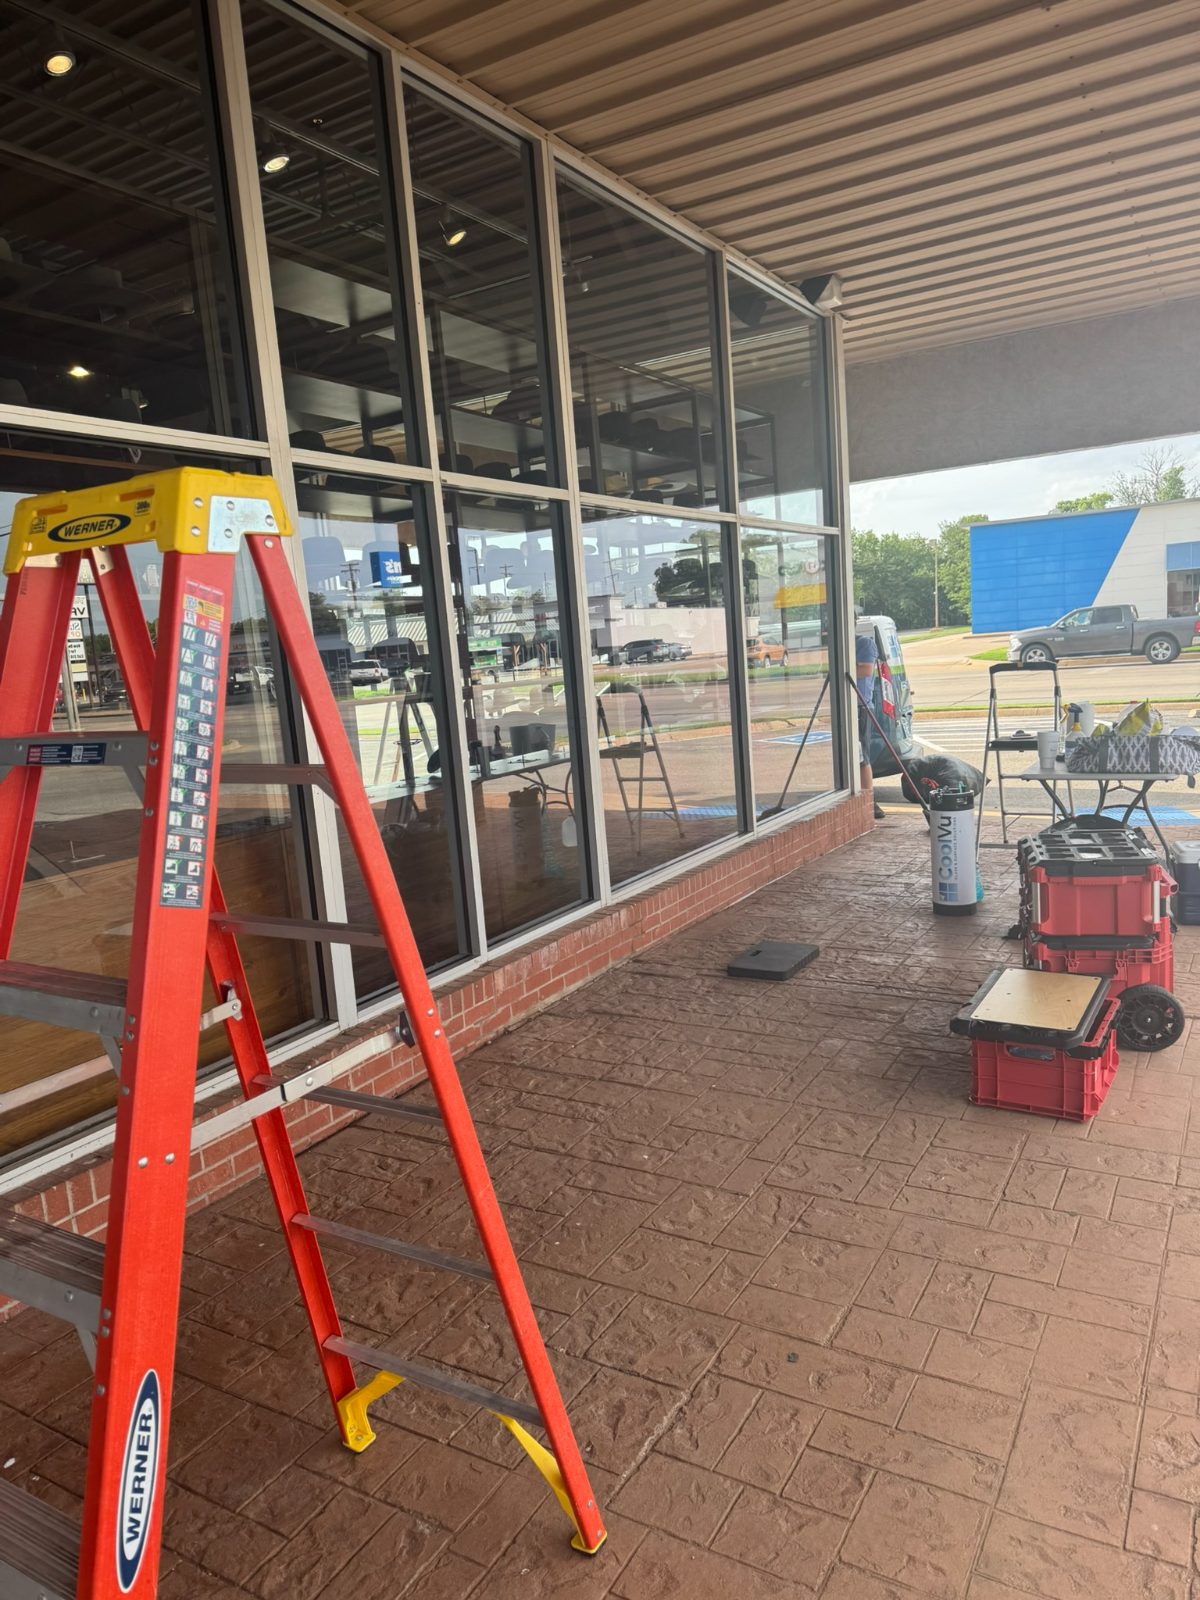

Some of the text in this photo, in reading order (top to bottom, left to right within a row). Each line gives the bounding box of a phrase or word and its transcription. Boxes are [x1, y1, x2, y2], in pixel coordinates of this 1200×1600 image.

[63, 519, 115, 537] WERNER
[937, 816, 952, 879] CoolVu
[126, 1412, 153, 1544] WERNER
